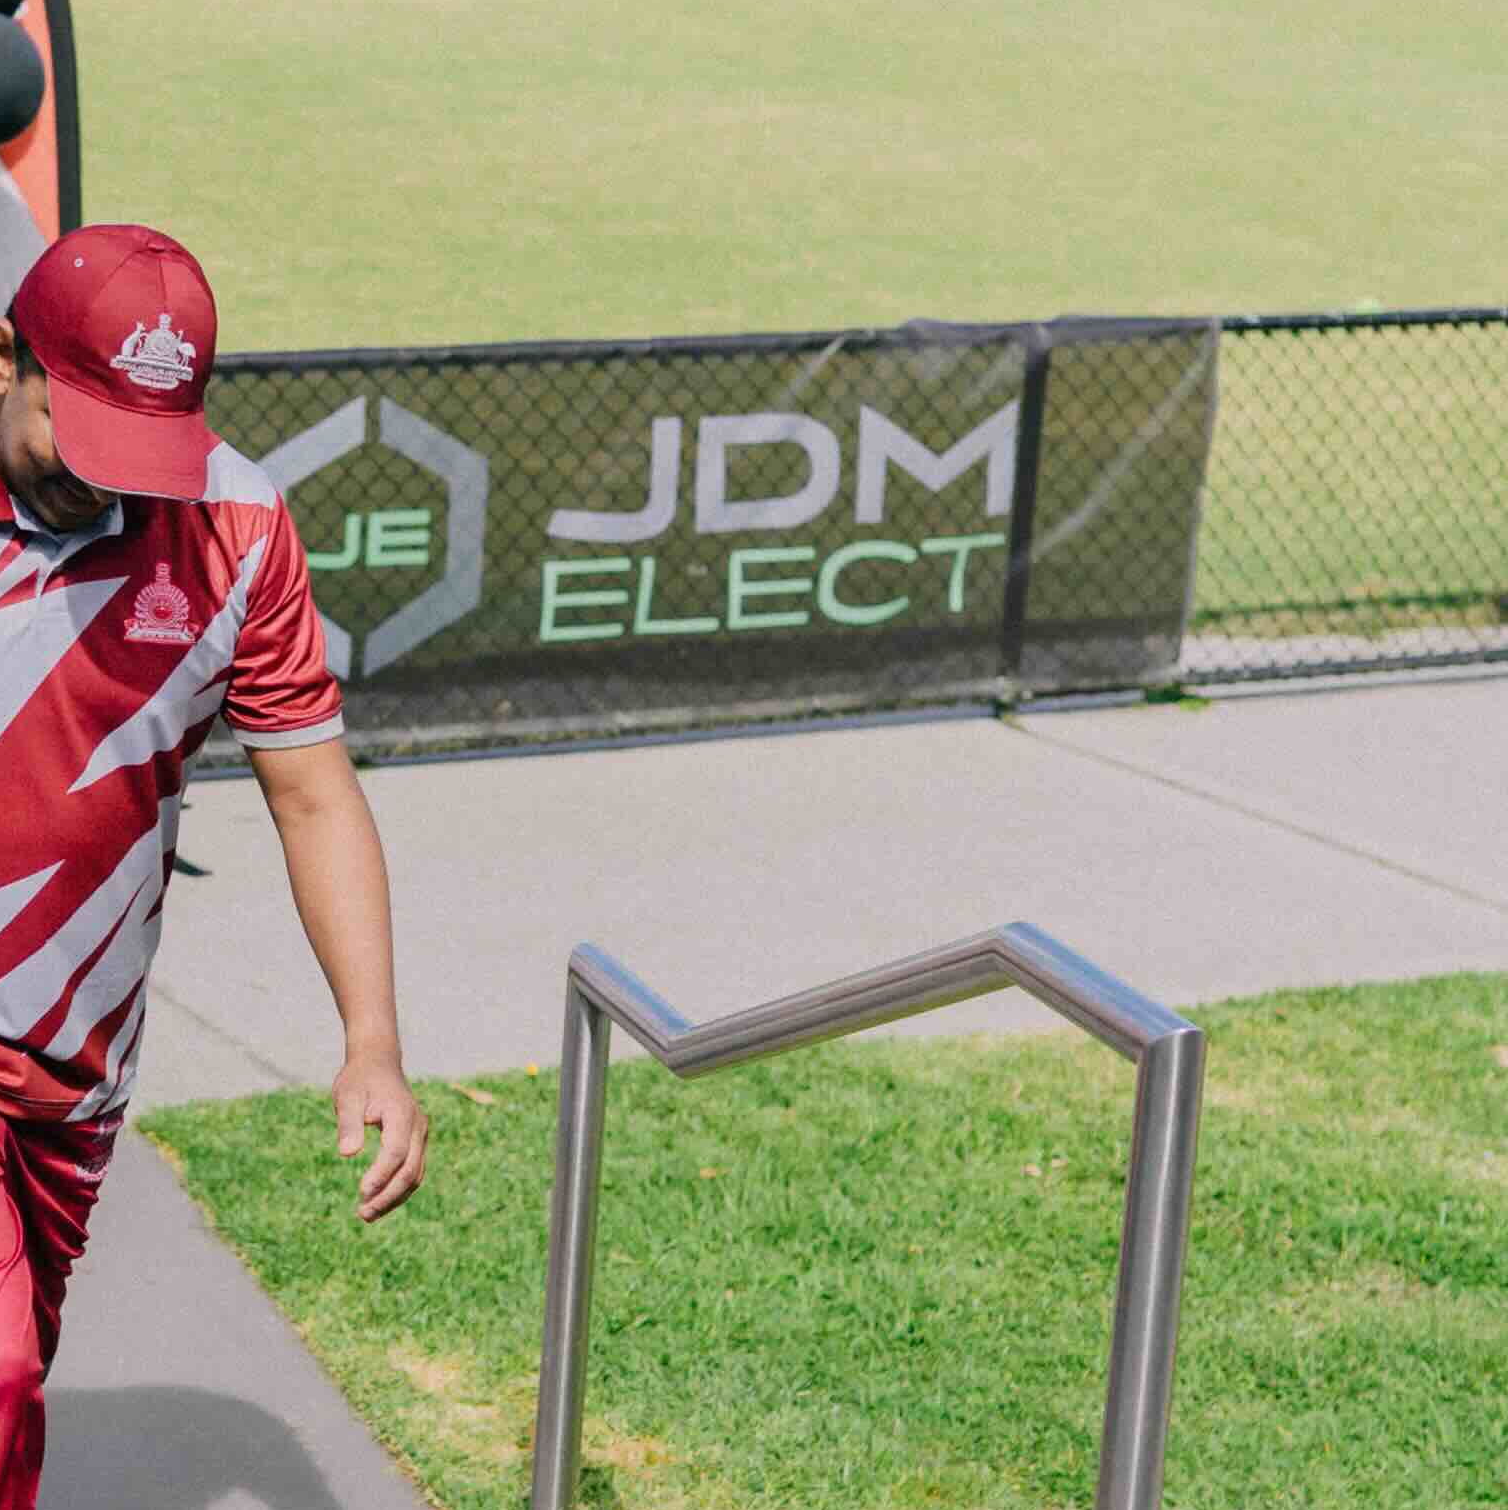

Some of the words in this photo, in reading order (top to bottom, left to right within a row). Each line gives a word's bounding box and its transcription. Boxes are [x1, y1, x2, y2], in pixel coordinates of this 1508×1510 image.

[547, 400, 1020, 543] JDM
[307, 509, 431, 570] JE
[539, 532, 1007, 644] ELECT
